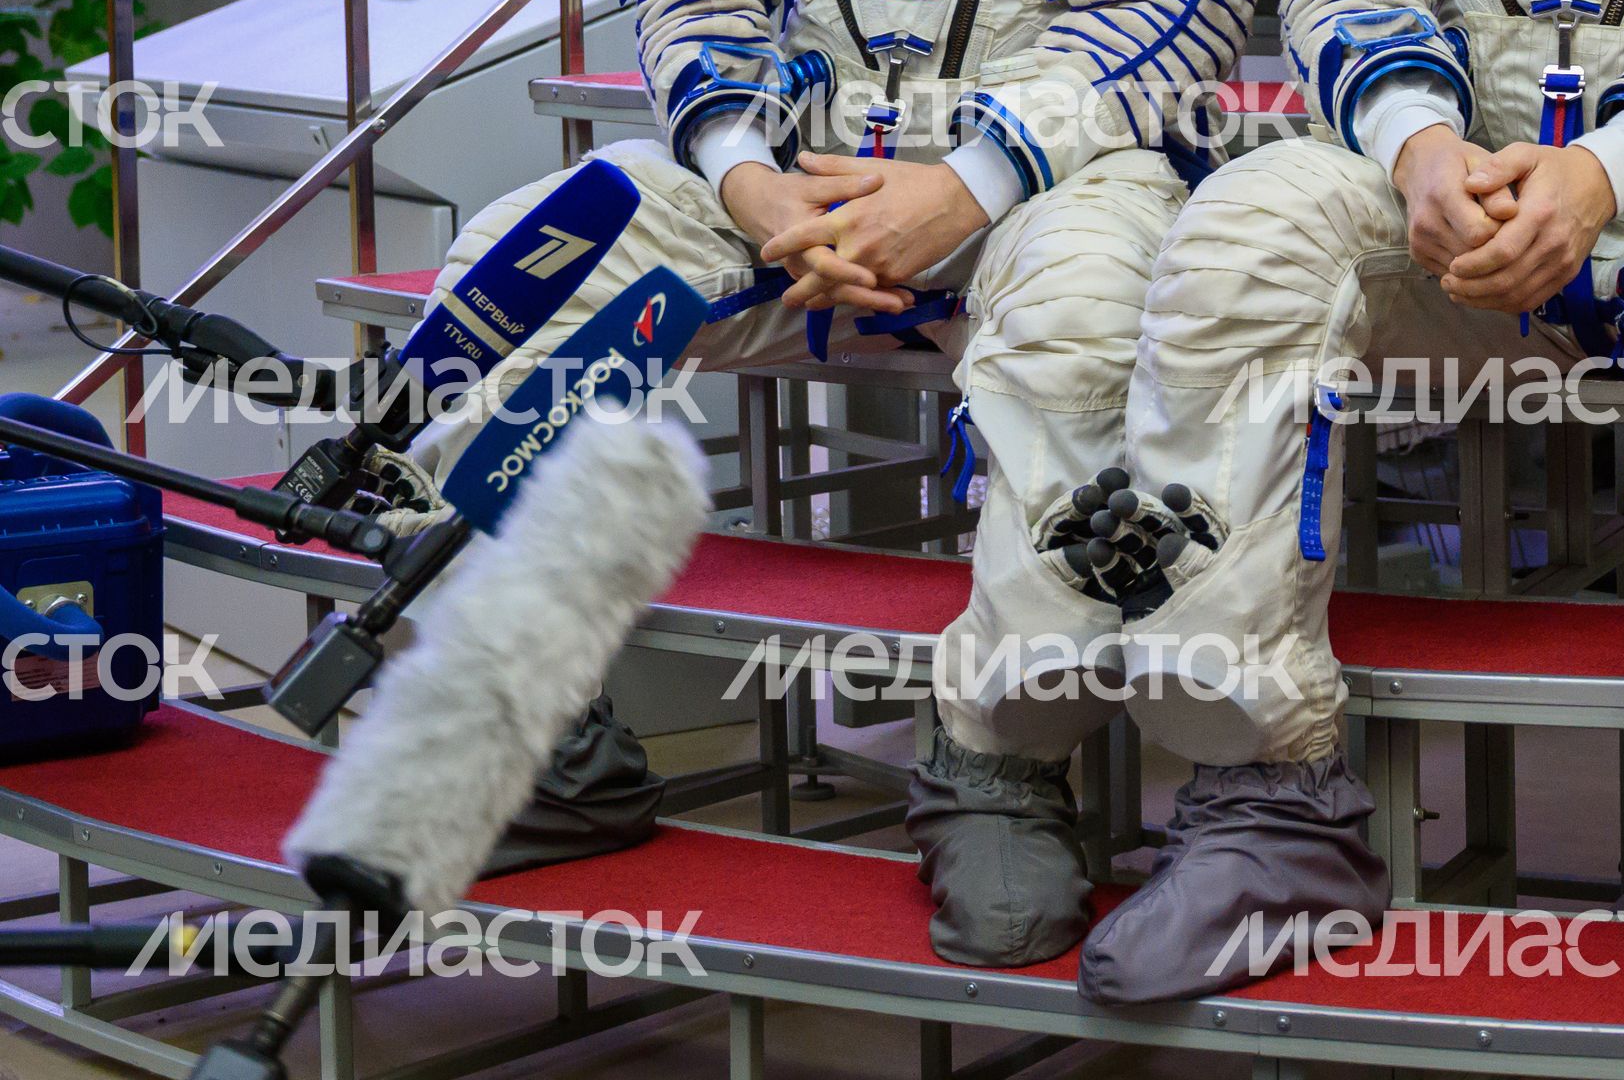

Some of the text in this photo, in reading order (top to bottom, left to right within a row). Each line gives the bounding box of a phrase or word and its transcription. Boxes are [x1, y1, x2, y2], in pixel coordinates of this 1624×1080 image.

[466, 286, 526, 336] ПЕРВЫЙ
[443, 322, 484, 361] 1TV.RU
[486, 346, 626, 493] РОСКОСМОС
